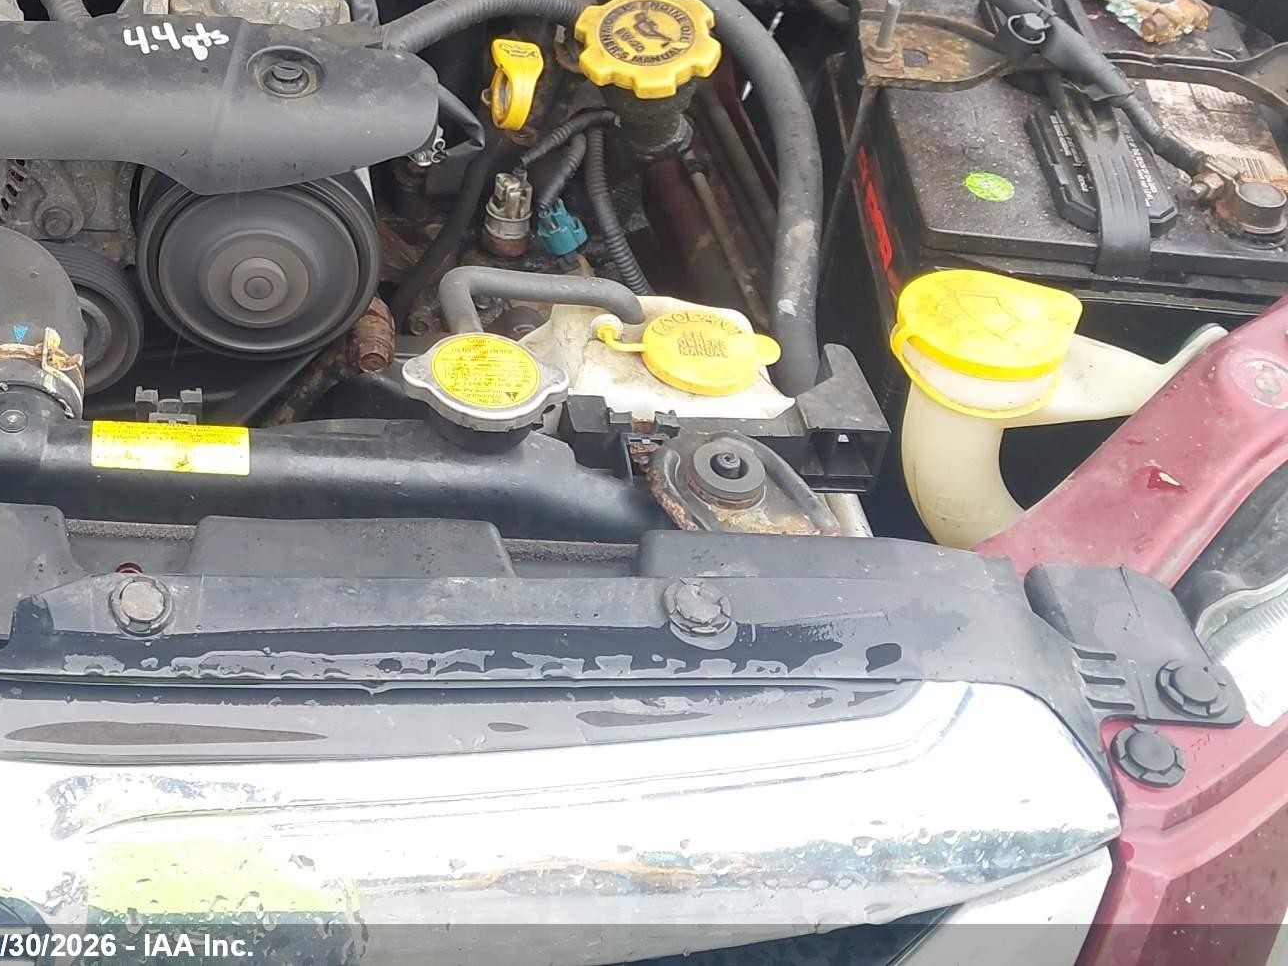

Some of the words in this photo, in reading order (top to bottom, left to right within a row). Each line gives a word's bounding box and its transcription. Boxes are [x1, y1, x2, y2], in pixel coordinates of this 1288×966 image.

[679, 23, 693, 43] OIL
[631, 46, 682, 64] MANUAL
[651, 310, 744, 336] COOLANT
[679, 347, 728, 358] MANUAL
